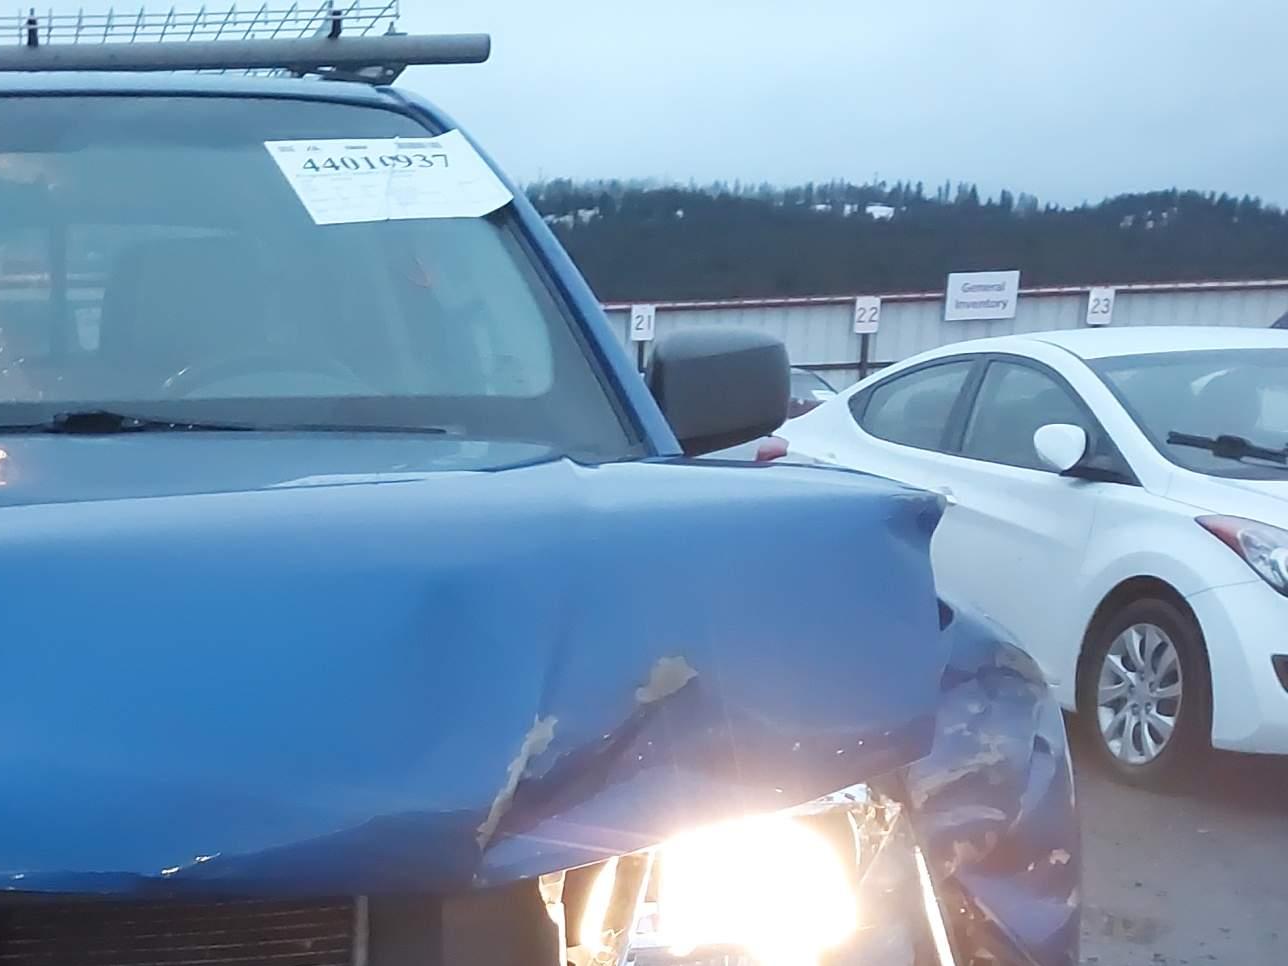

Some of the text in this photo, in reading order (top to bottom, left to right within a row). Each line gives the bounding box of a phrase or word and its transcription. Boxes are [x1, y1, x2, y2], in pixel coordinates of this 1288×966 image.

[302, 153, 450, 173] 44010937
[961, 281, 1007, 294] General
[954, 298, 1009, 311] Inventory
[1090, 297, 1111, 315] 23
[634, 313, 653, 332] 21
[856, 306, 880, 324] 22
